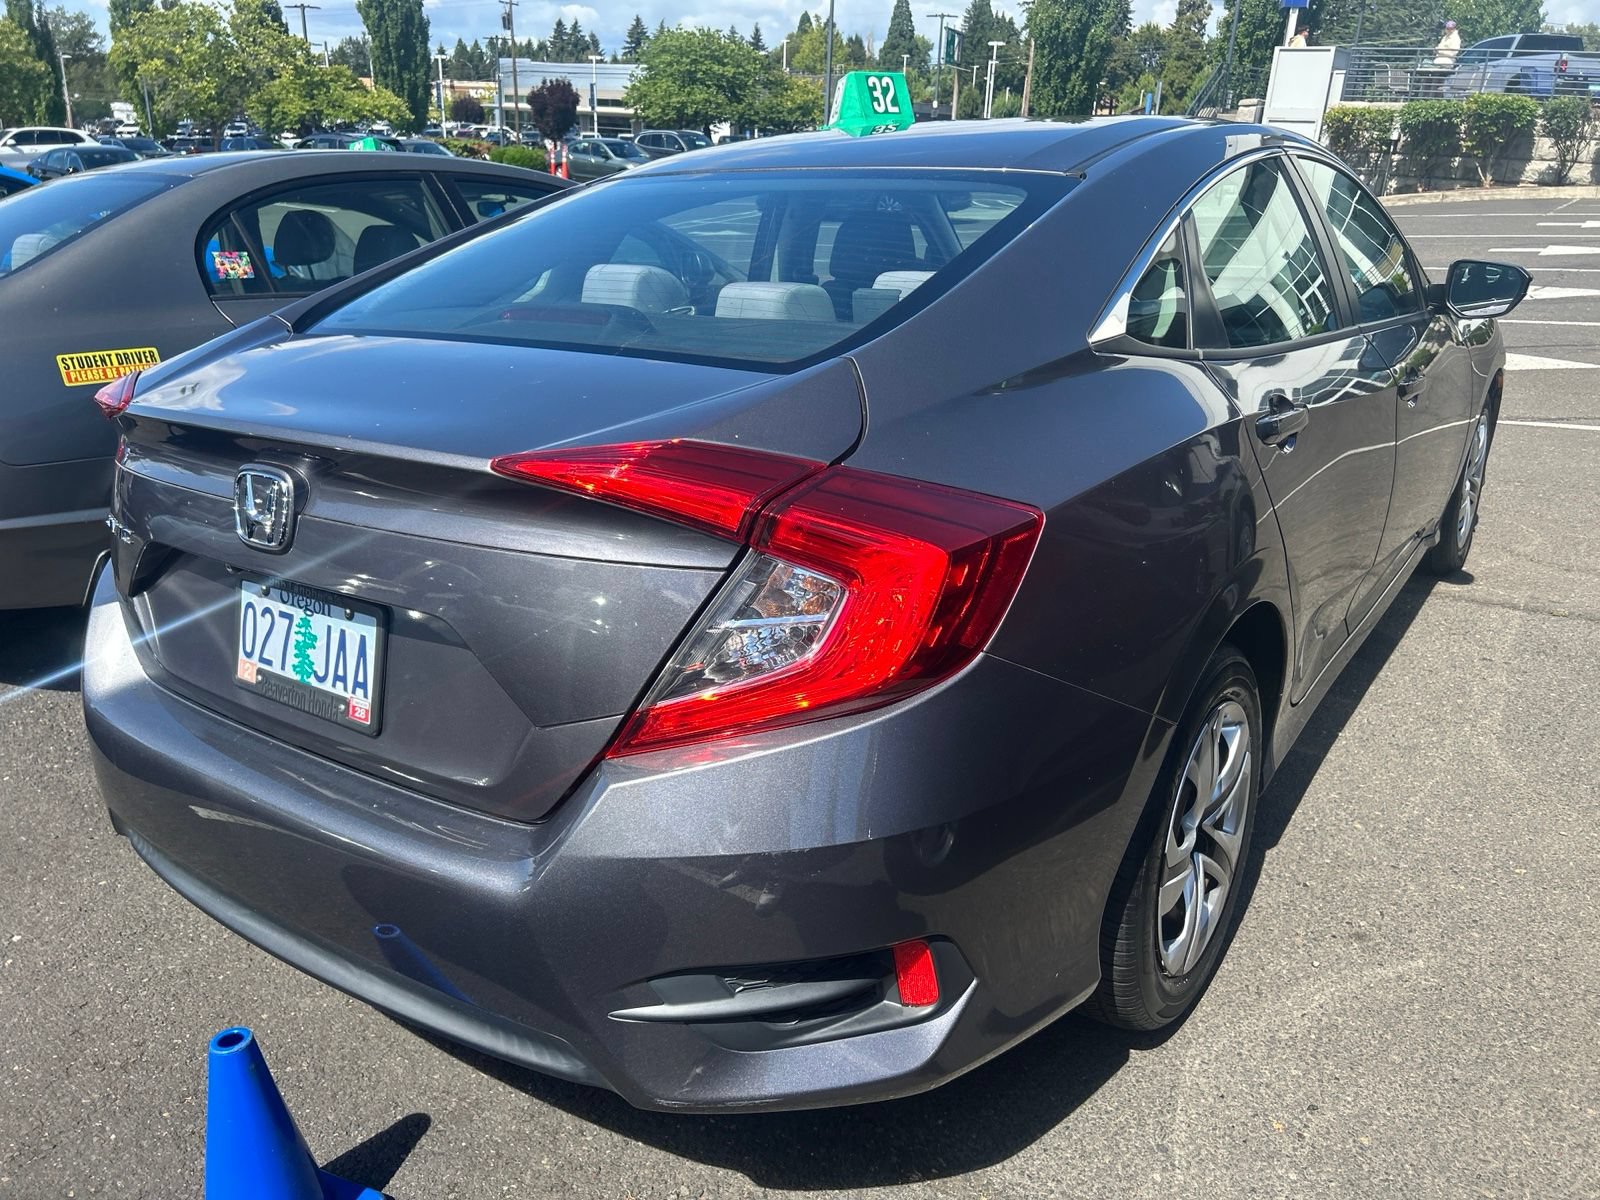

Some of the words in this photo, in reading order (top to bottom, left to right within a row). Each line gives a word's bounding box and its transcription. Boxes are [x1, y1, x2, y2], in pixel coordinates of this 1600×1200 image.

[868, 76, 899, 113] 32
[61, 353, 113, 371] STUDENT
[115, 350, 158, 366] DRIVER
[71, 368, 105, 383] PLEASE
[107, 367, 119, 379] BE
[279, 590, 332, 618] Oregon
[242, 601, 294, 671] 027
[314, 624, 369, 699] JAA
[354, 707, 366, 719] 28
